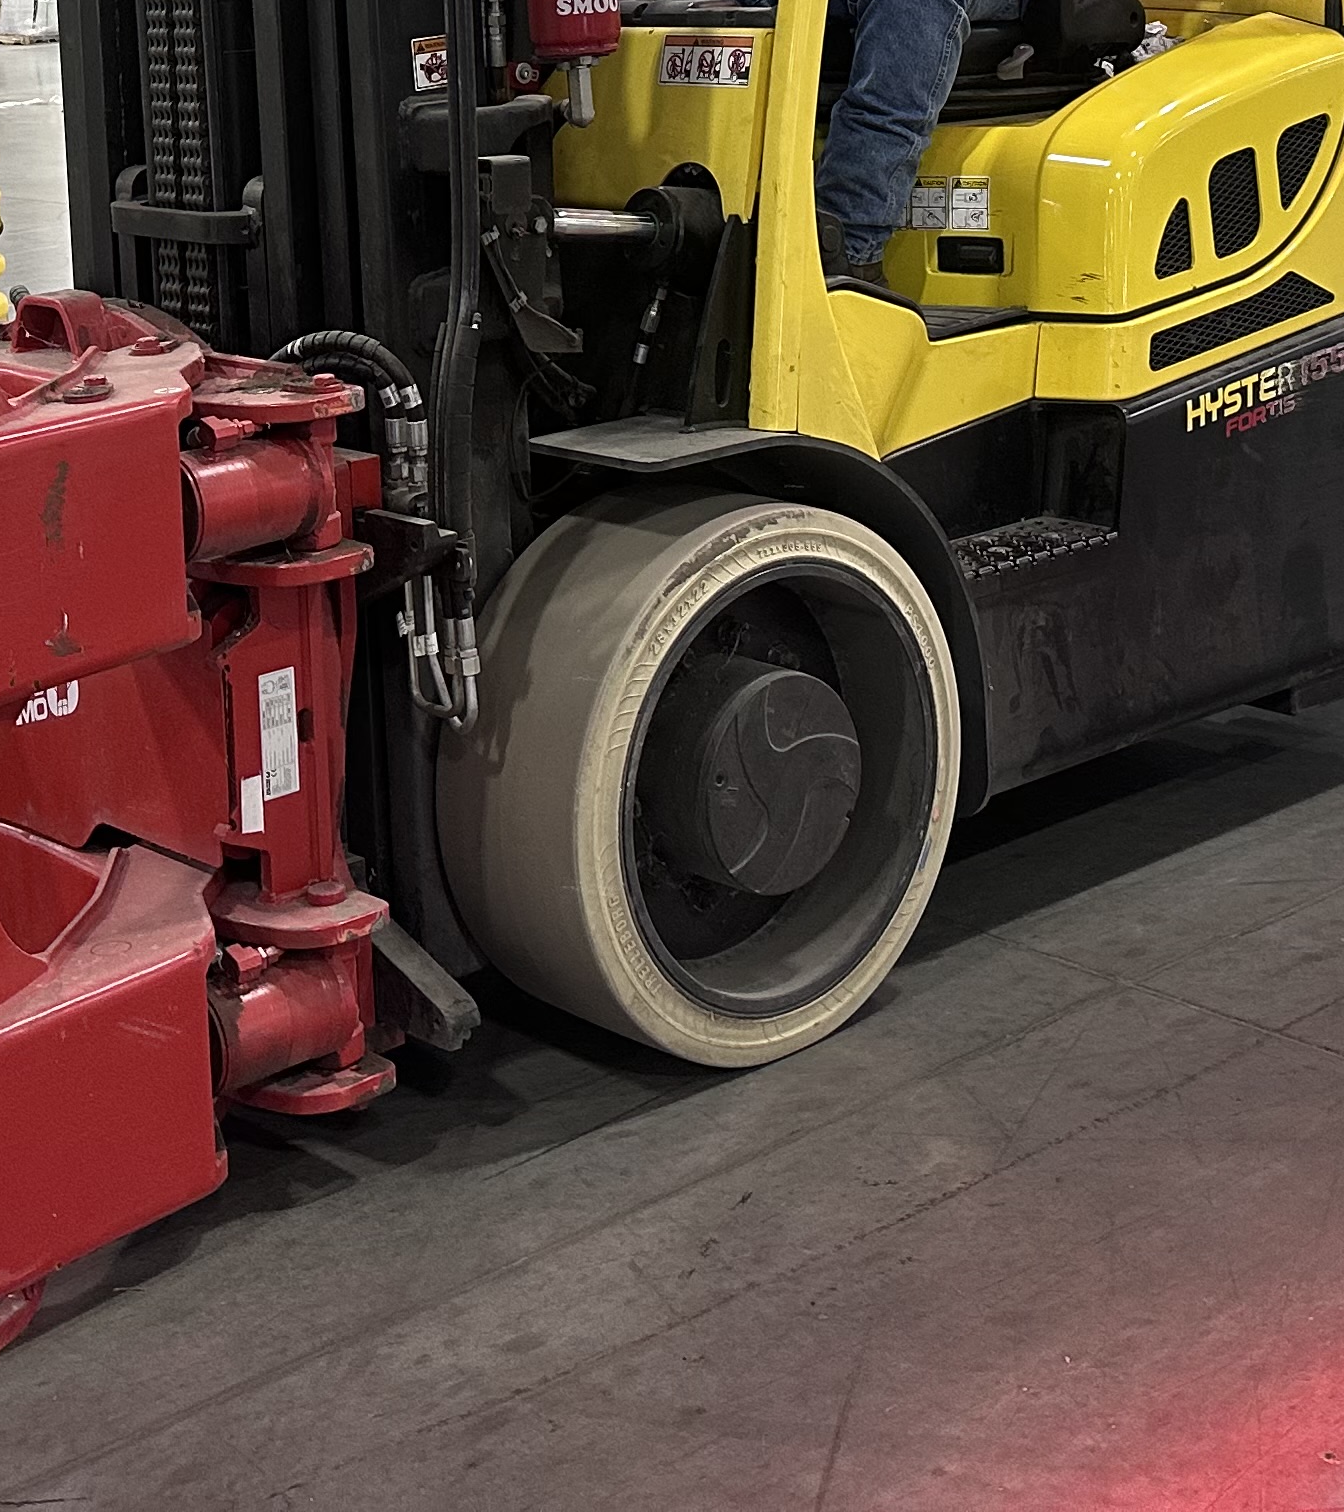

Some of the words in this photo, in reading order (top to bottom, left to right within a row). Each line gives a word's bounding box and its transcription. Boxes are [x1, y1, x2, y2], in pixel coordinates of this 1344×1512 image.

[1186, 361, 1296, 432] HYSTER
[1225, 394, 1296, 438] FORTIS
[608, 895, 662, 997] TRELLEBORG
